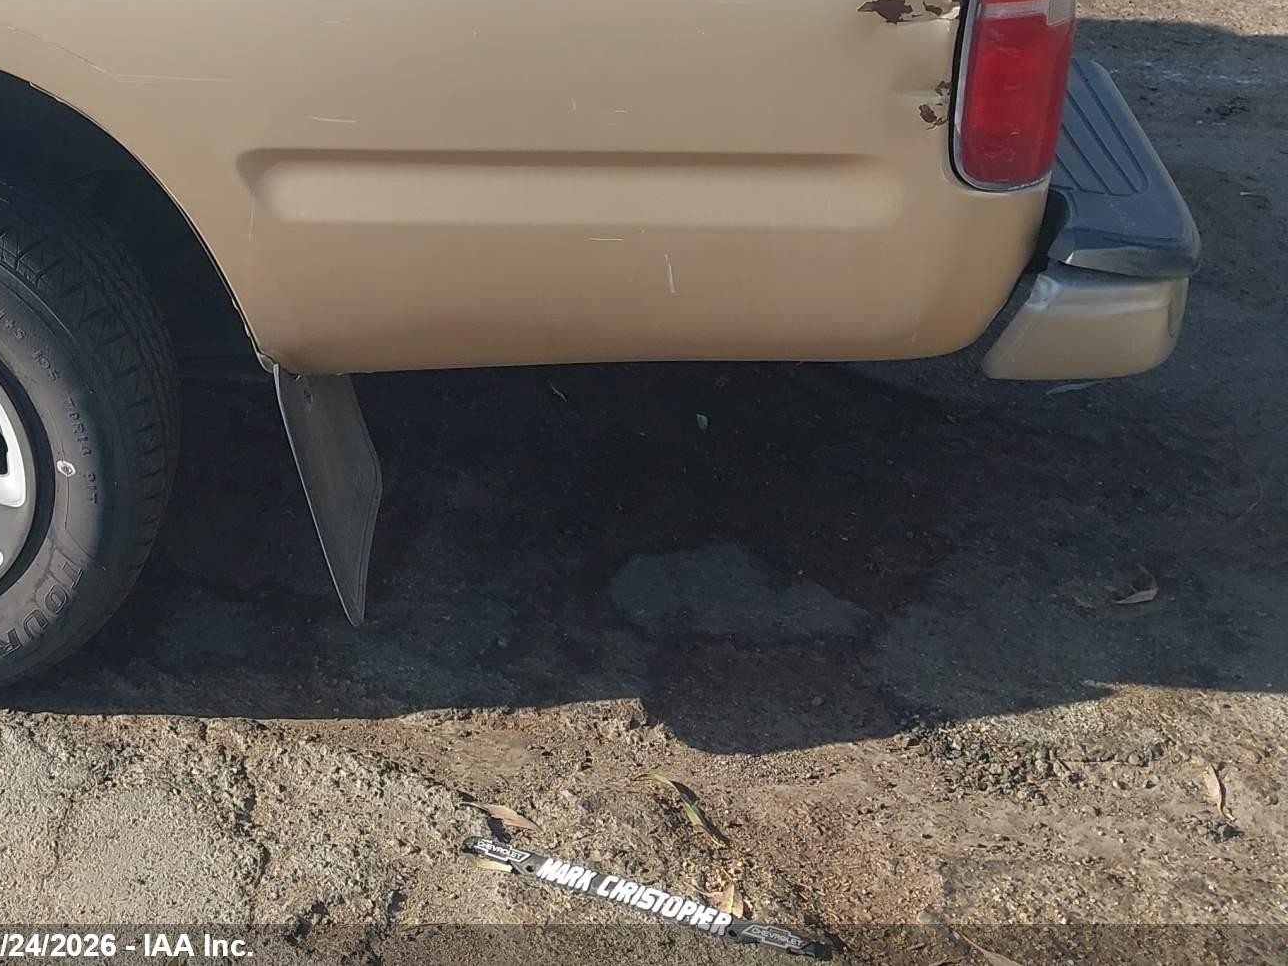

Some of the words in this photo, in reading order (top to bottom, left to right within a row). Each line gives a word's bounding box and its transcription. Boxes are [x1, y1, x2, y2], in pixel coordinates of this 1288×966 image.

[475, 838, 524, 860] CHEVROLET
[536, 857, 598, 892] MARK
[596, 874, 733, 936] CHRISTOPHER
[751, 926, 803, 947] CHEVROLET
